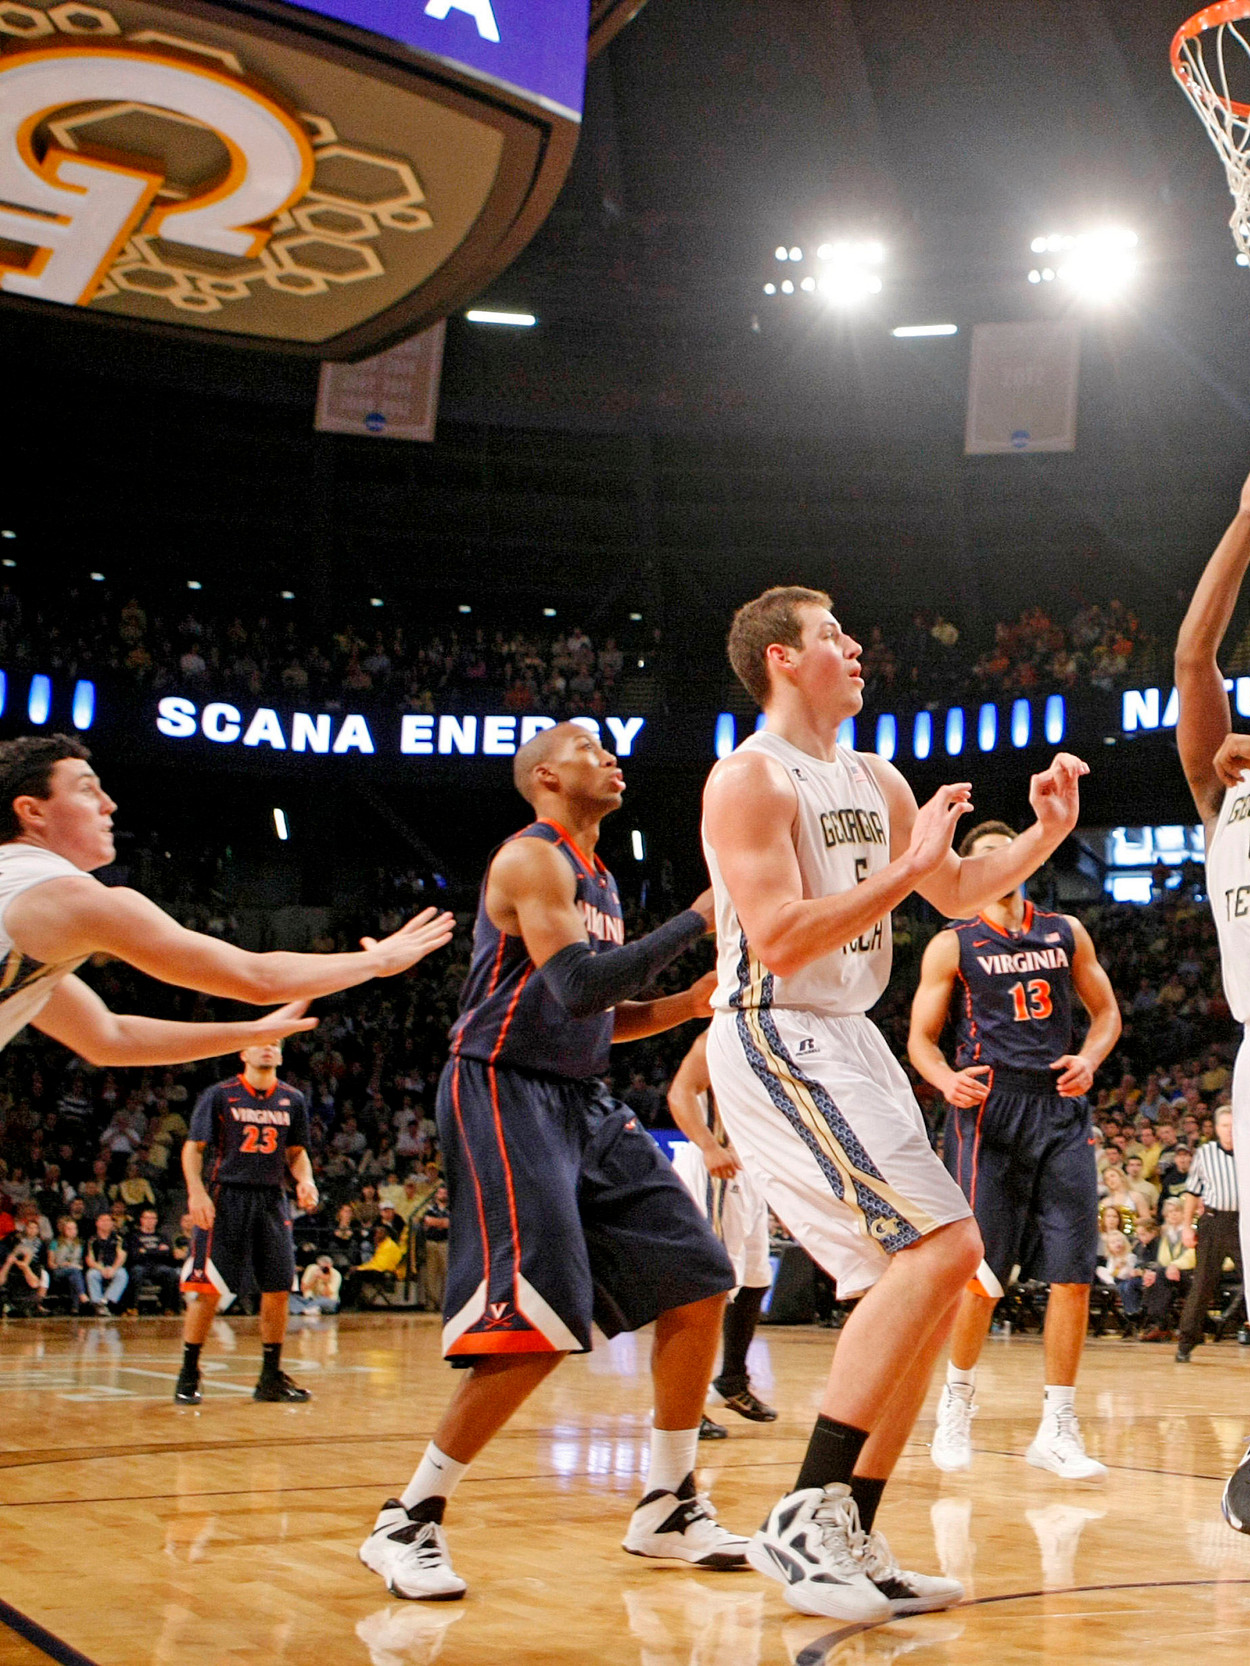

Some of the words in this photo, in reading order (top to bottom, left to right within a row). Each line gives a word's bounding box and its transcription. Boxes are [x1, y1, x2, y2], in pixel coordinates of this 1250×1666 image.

[155, 696, 376, 754] SCANA
[820, 808, 888, 849] GEORGIA
[976, 947, 1069, 976] VIRGINIA
[1008, 978, 1053, 1021] 13
[230, 1106, 291, 1127] VIRGINIA
[239, 1124, 279, 1154] 23
